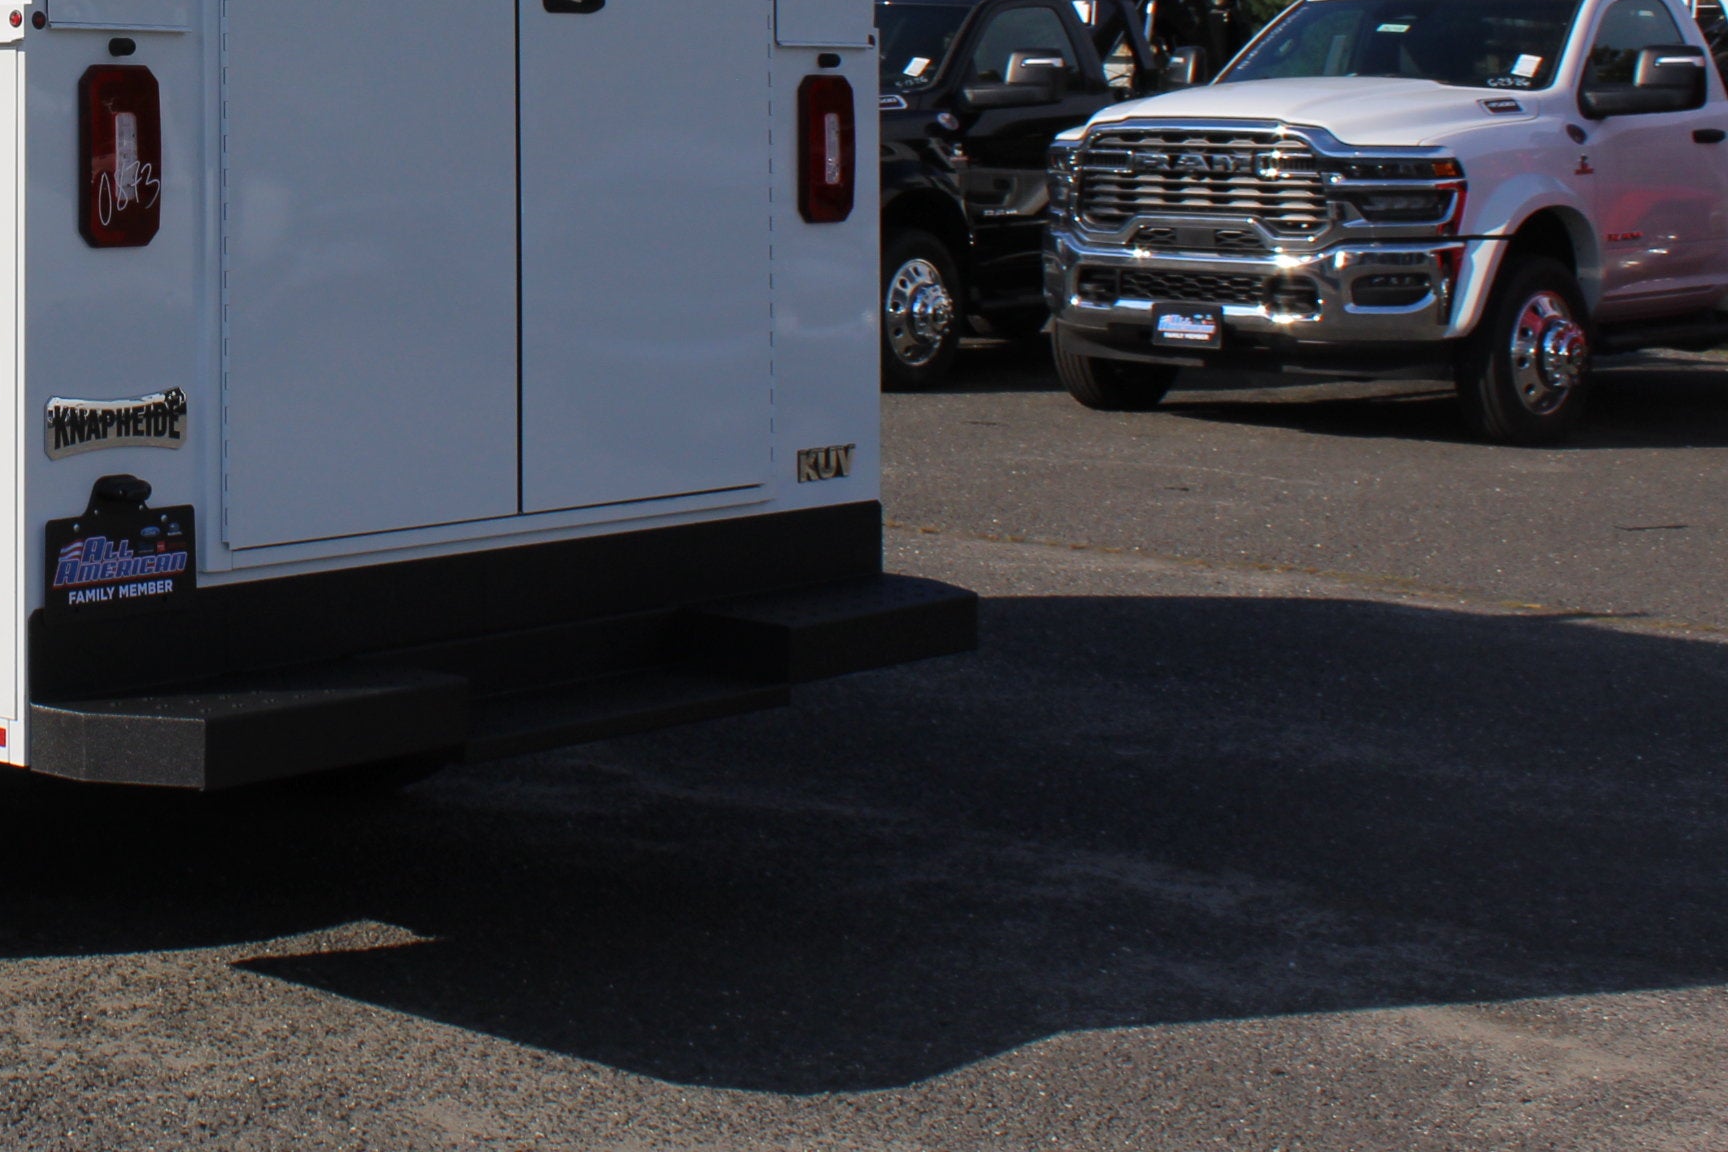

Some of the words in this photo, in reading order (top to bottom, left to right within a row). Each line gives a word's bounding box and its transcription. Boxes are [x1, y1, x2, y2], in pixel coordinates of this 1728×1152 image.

[1133, 152, 1252, 172] RAM
[53, 403, 181, 450] KNAPHEIDE
[797, 443, 856, 483] KUV
[68, 586, 115, 605] FAMILY
[118, 579, 174, 599] MEMBER
